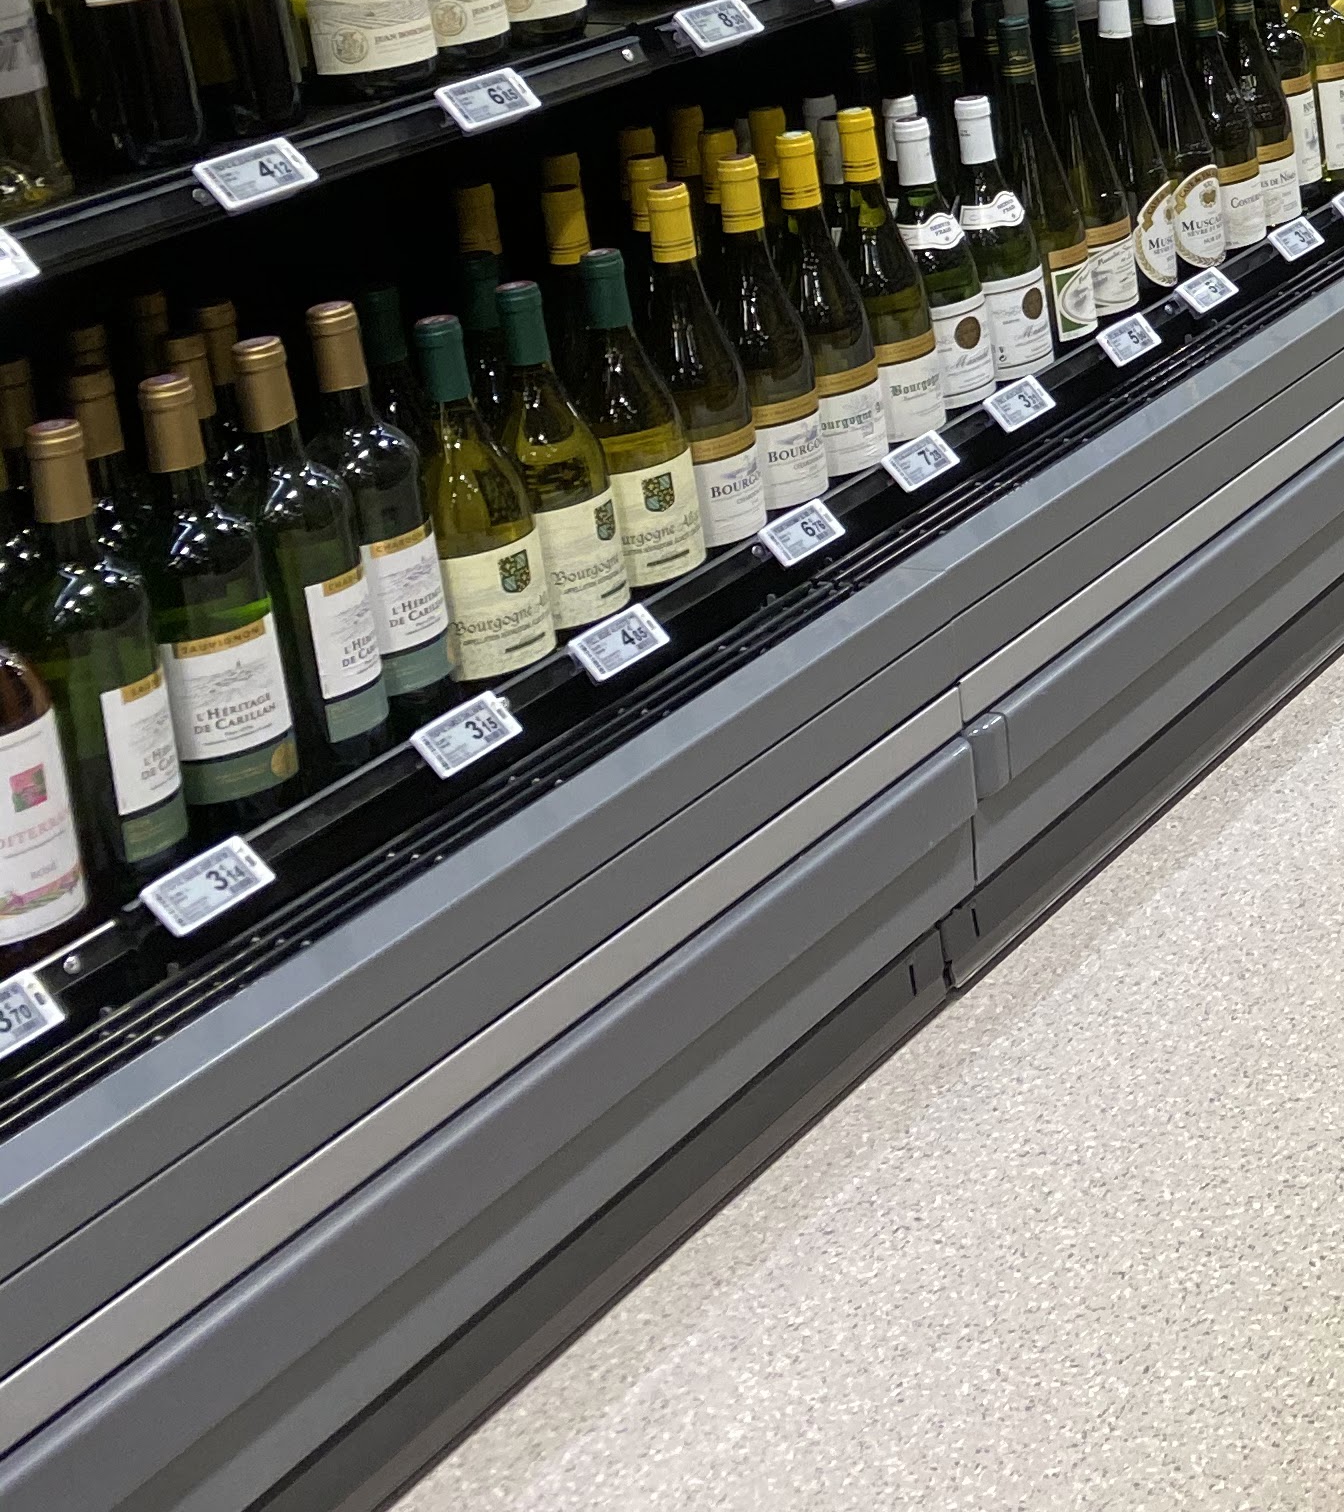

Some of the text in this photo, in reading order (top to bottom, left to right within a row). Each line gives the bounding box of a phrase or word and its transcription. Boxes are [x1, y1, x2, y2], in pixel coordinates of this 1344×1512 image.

[390, 616, 405, 628] DE
[449, 605, 533, 637] Bourgogne
[180, 626, 260, 655] SAUVIGNON
[342, 655, 357, 668] DE
[193, 720, 213, 735] DE
